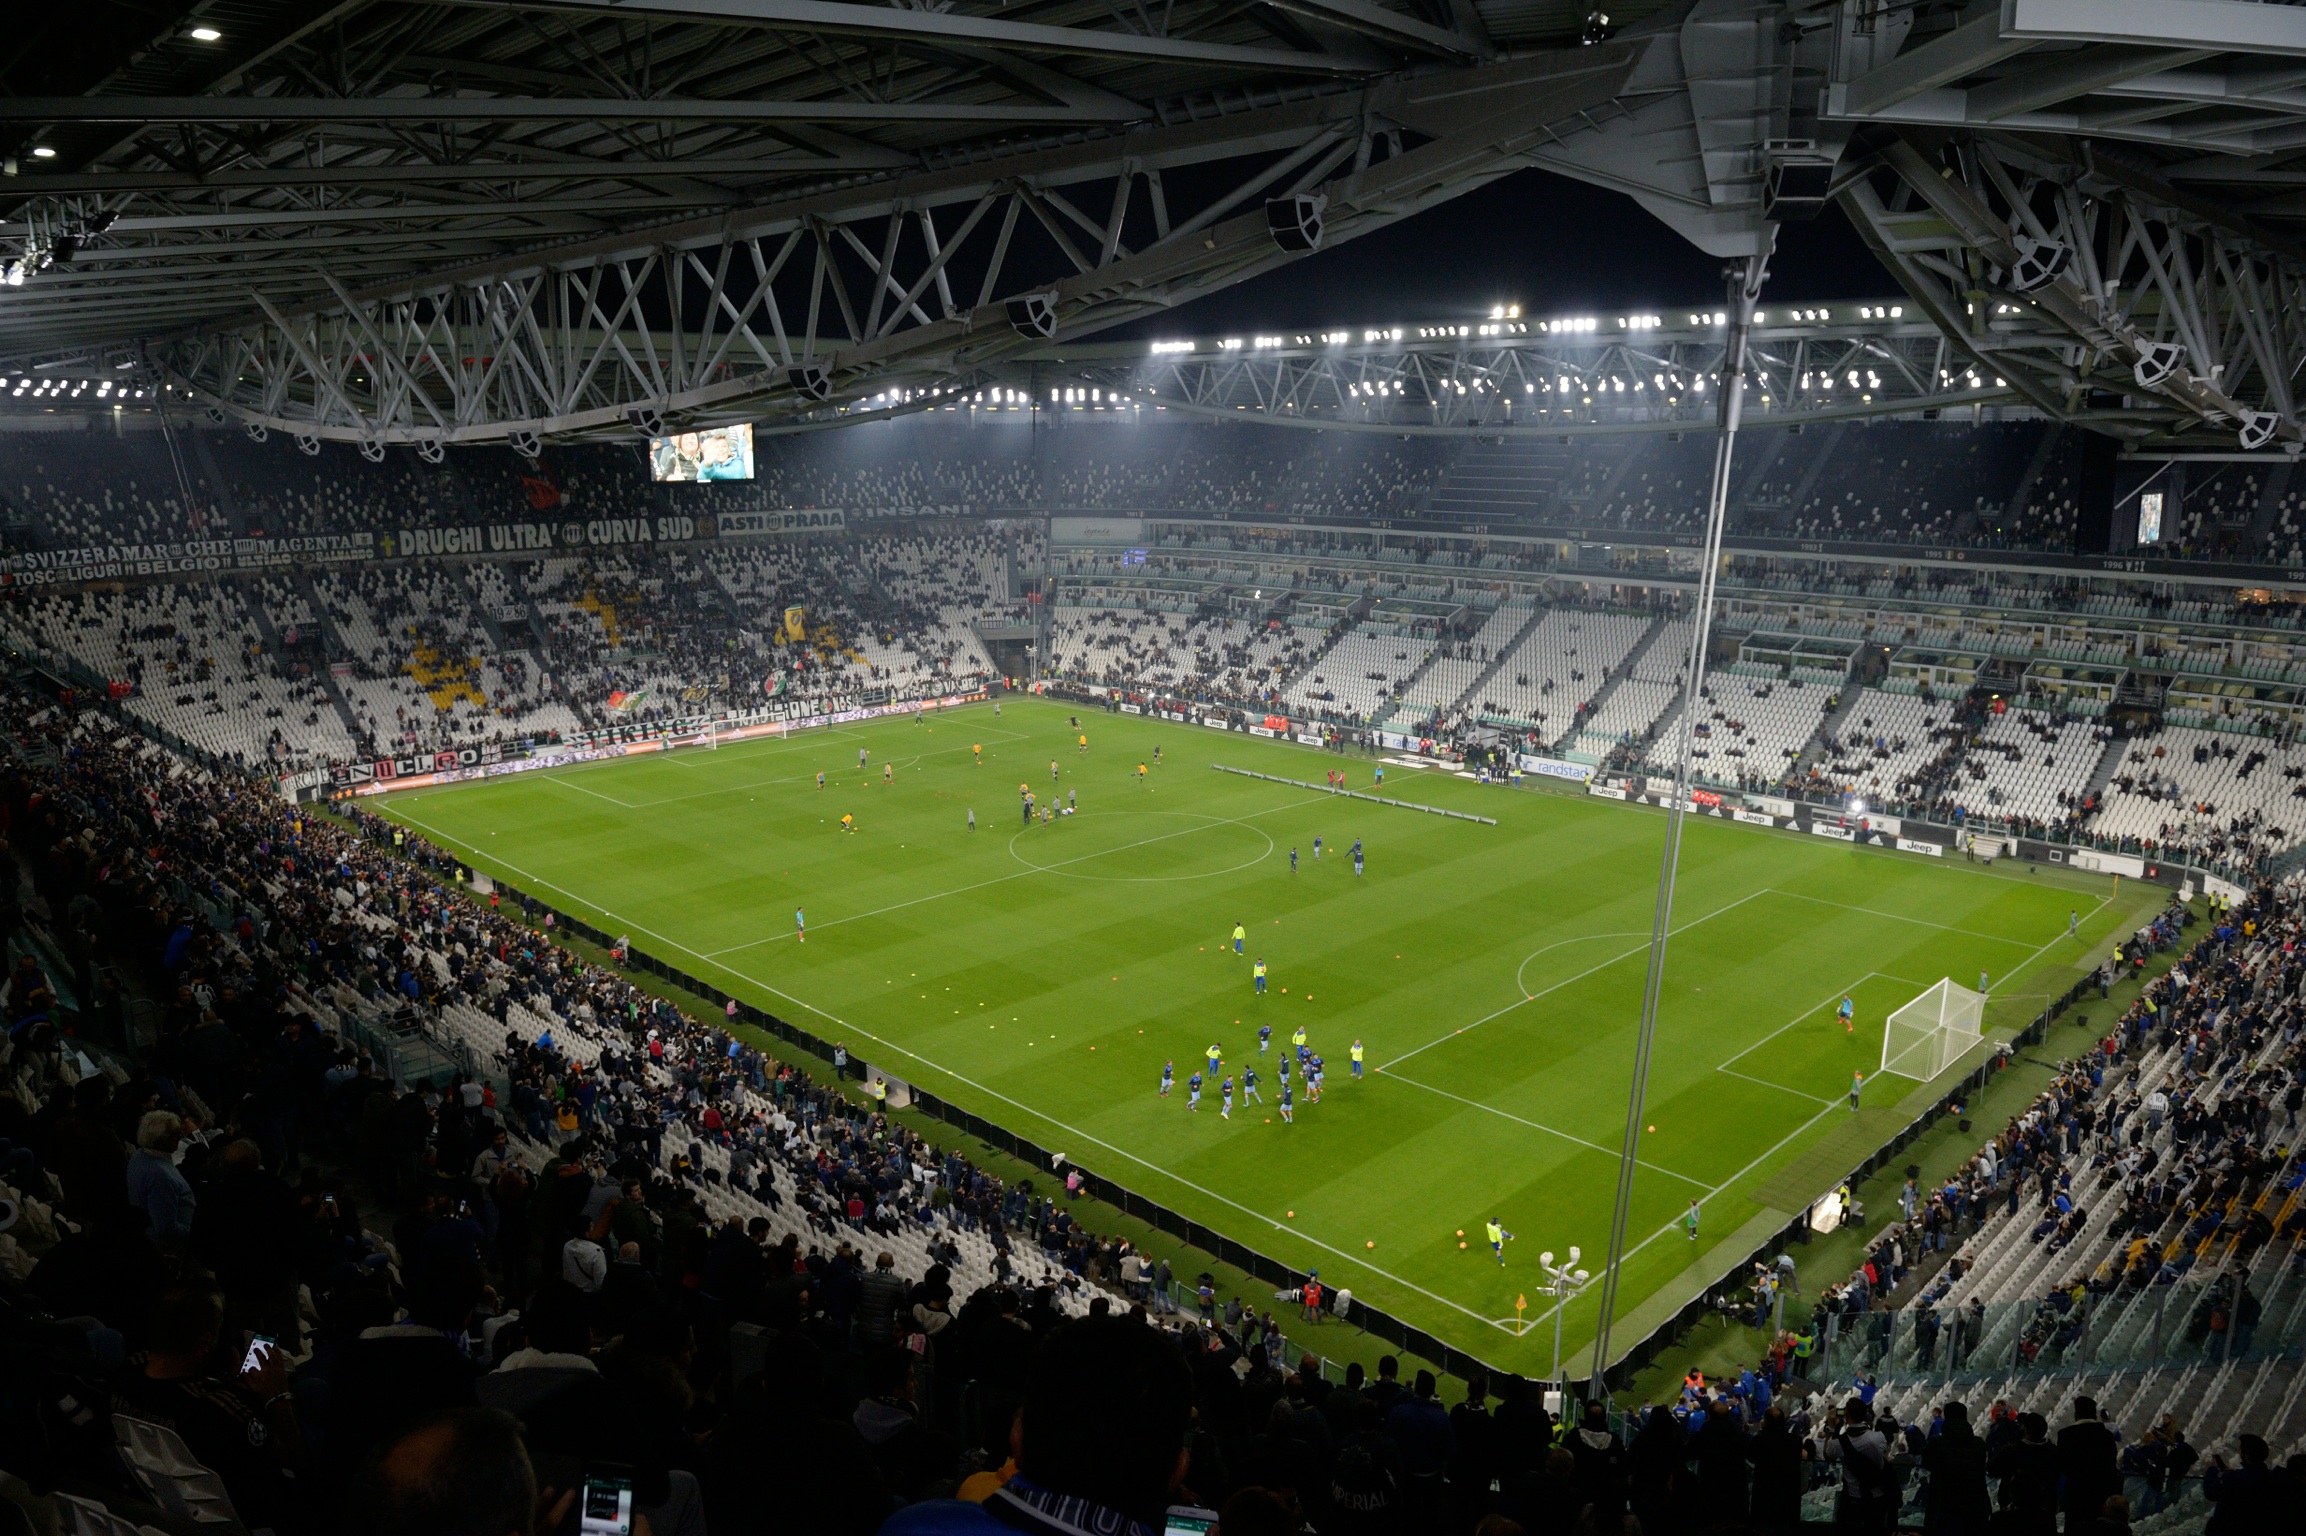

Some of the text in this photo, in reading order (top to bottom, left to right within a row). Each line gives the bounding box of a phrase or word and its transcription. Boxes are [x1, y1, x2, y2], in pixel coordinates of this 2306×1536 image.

[866, 504, 970, 518] INSANI
[721, 512, 844, 531] ASTI PRAIA
[398, 516, 695, 556] DRUGHI ULTRA' CURVA SUD
[257, 535, 352, 554] MAGENTA
[1801, 543, 1818, 551] 1993
[24, 545, 120, 570] SVIZZERA
[1924, 550, 1943, 559] 1995
[67, 562, 122, 581] LIGURI
[137, 556, 220, 575] BELGIO
[2103, 560, 2124, 569] 1996
[12, 569, 56, 585] TOSC
[2287, 571, 2306, 580] 199
[1209, 719, 1223, 728] Jeep
[585, 717, 688, 748] VIKING
[1255, 727, 1269, 736] Jeep
[1303, 736, 1318, 745] Jeep
[1538, 762, 1588, 779] randstad
[1598, 787, 1618, 797] Jeep
[1743, 812, 1765, 824] Jeep
[1822, 826, 1845, 838] Jeep
[1907, 840, 1932, 854] Jeep
